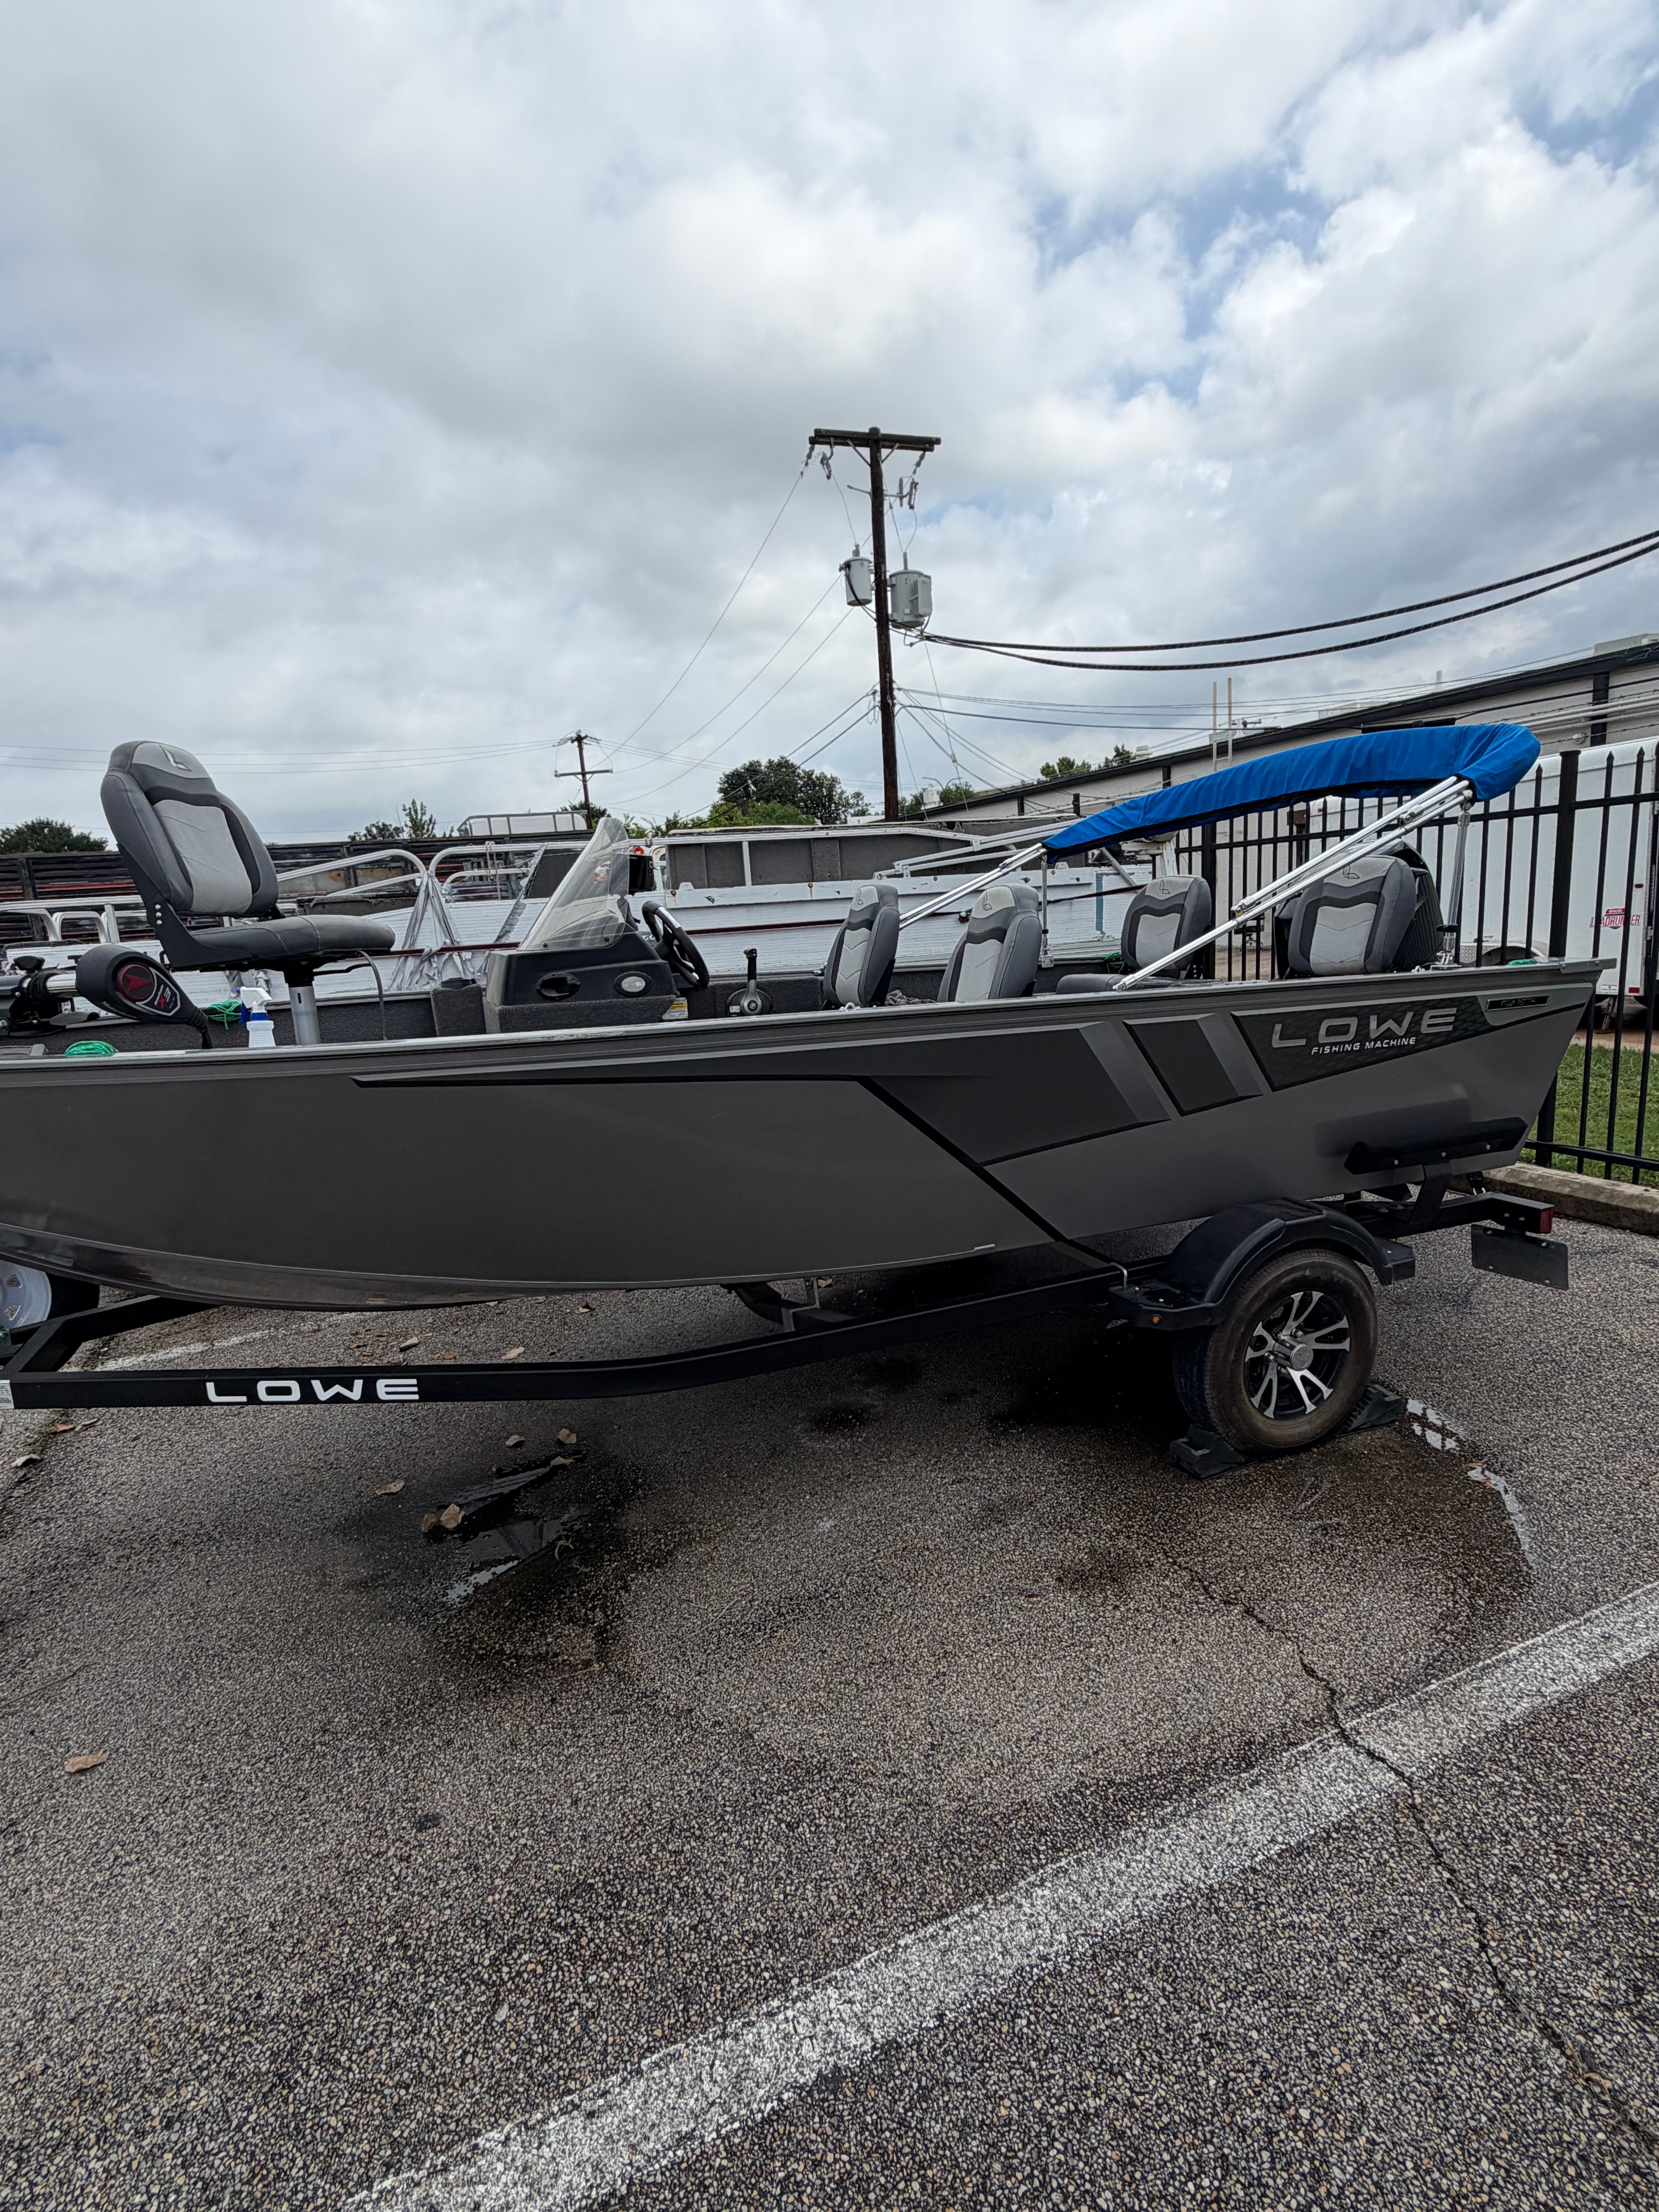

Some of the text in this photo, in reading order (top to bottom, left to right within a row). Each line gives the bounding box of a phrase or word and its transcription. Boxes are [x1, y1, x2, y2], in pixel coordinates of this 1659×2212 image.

[1272, 1008, 1457, 1048] LOWE
[1311, 1037, 1416, 1055] FISHING MACHINE
[206, 1379, 419, 1402] LOWE
